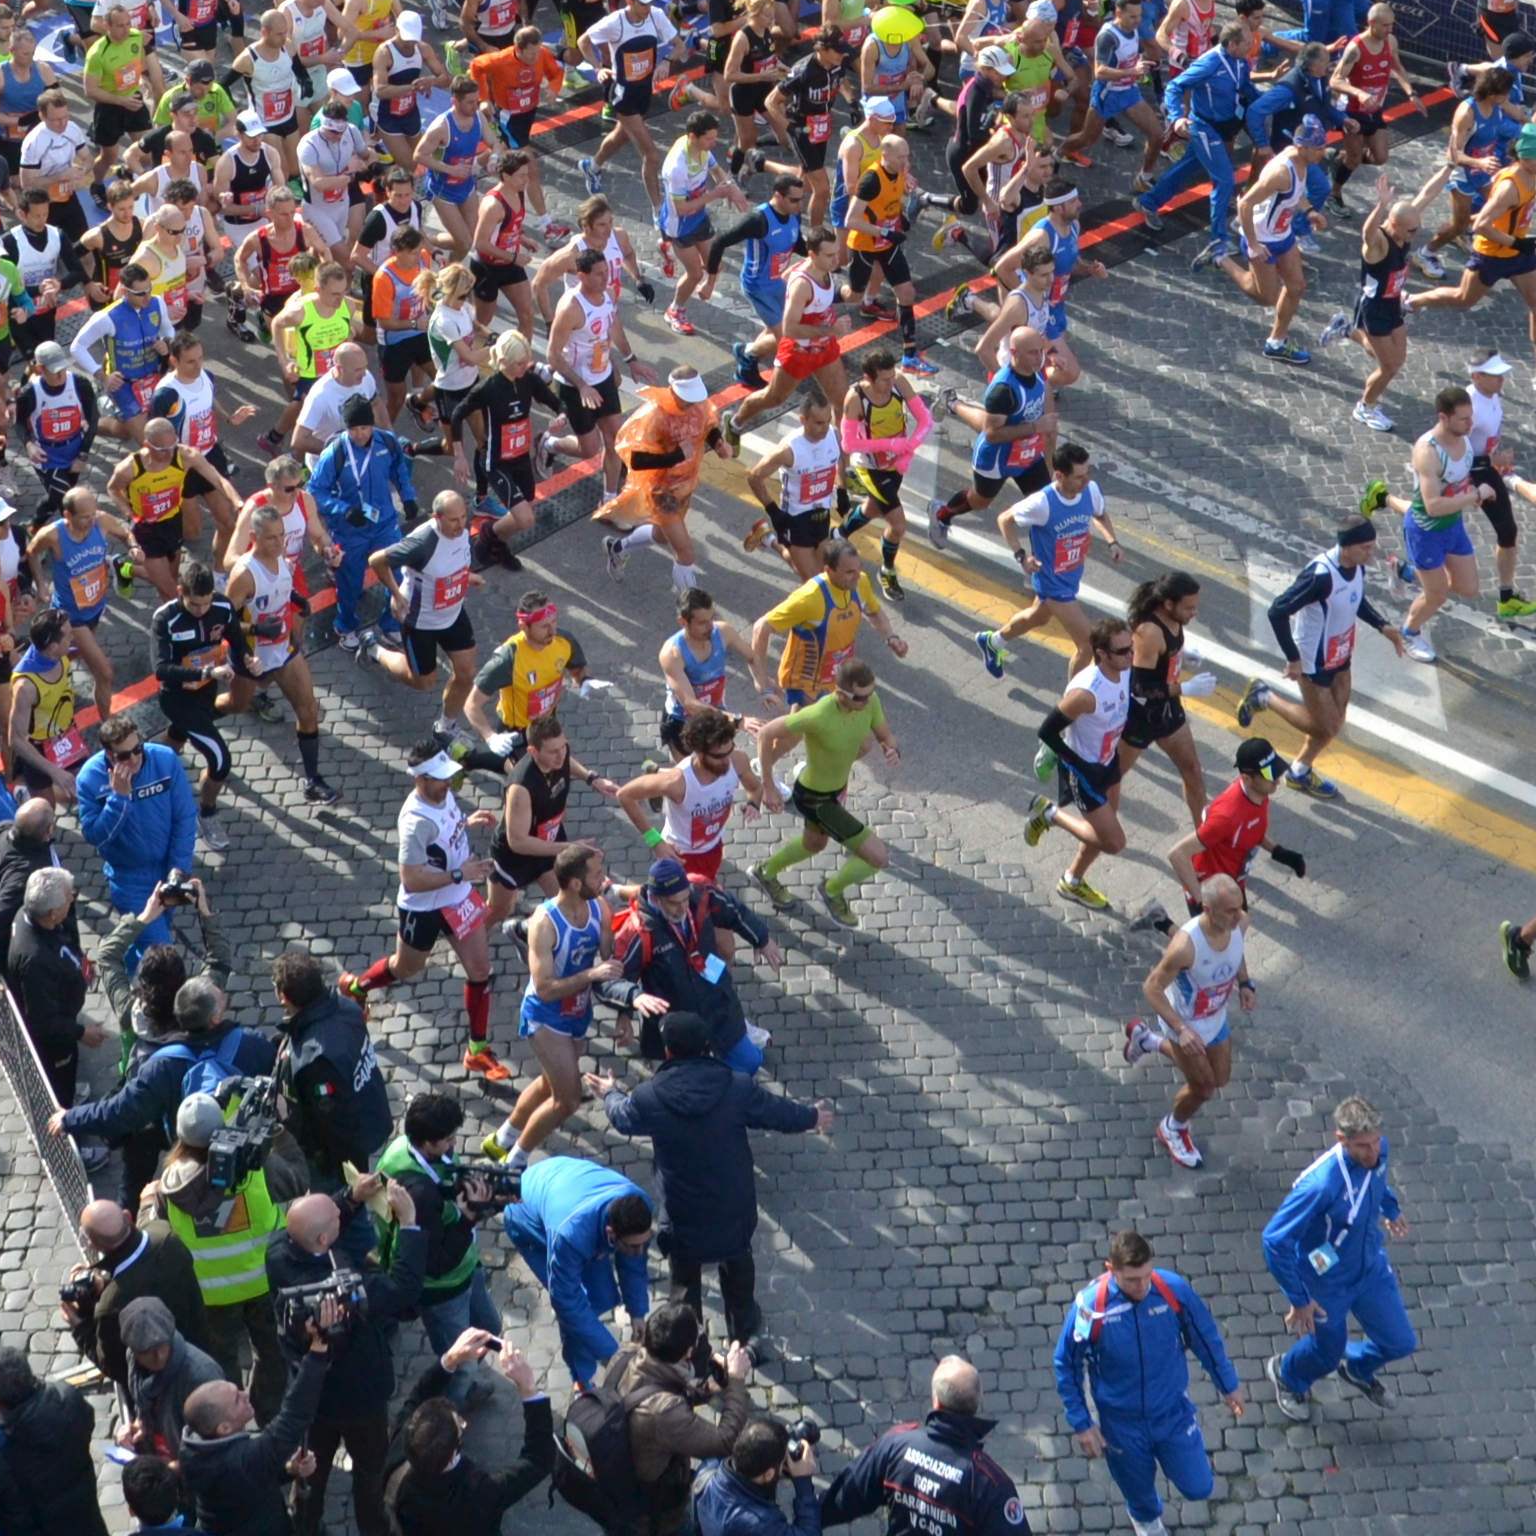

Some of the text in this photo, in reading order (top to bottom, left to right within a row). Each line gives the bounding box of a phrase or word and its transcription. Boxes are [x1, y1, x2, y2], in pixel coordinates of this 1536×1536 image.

[275, 100, 286, 112] 177
[52, 420, 72, 433] 318
[1020, 447, 1035, 459] 134
[809, 483, 828, 495] 306
[153, 500, 171, 514] 321
[1068, 548, 1081, 560] 171
[445, 585, 462, 600] 324
[836, 610, 854, 622] FILA
[53, 739, 72, 756] 163
[138, 784, 164, 799] CITO
[904, 1446, 964, 1485] ASSOCIAZIONE
